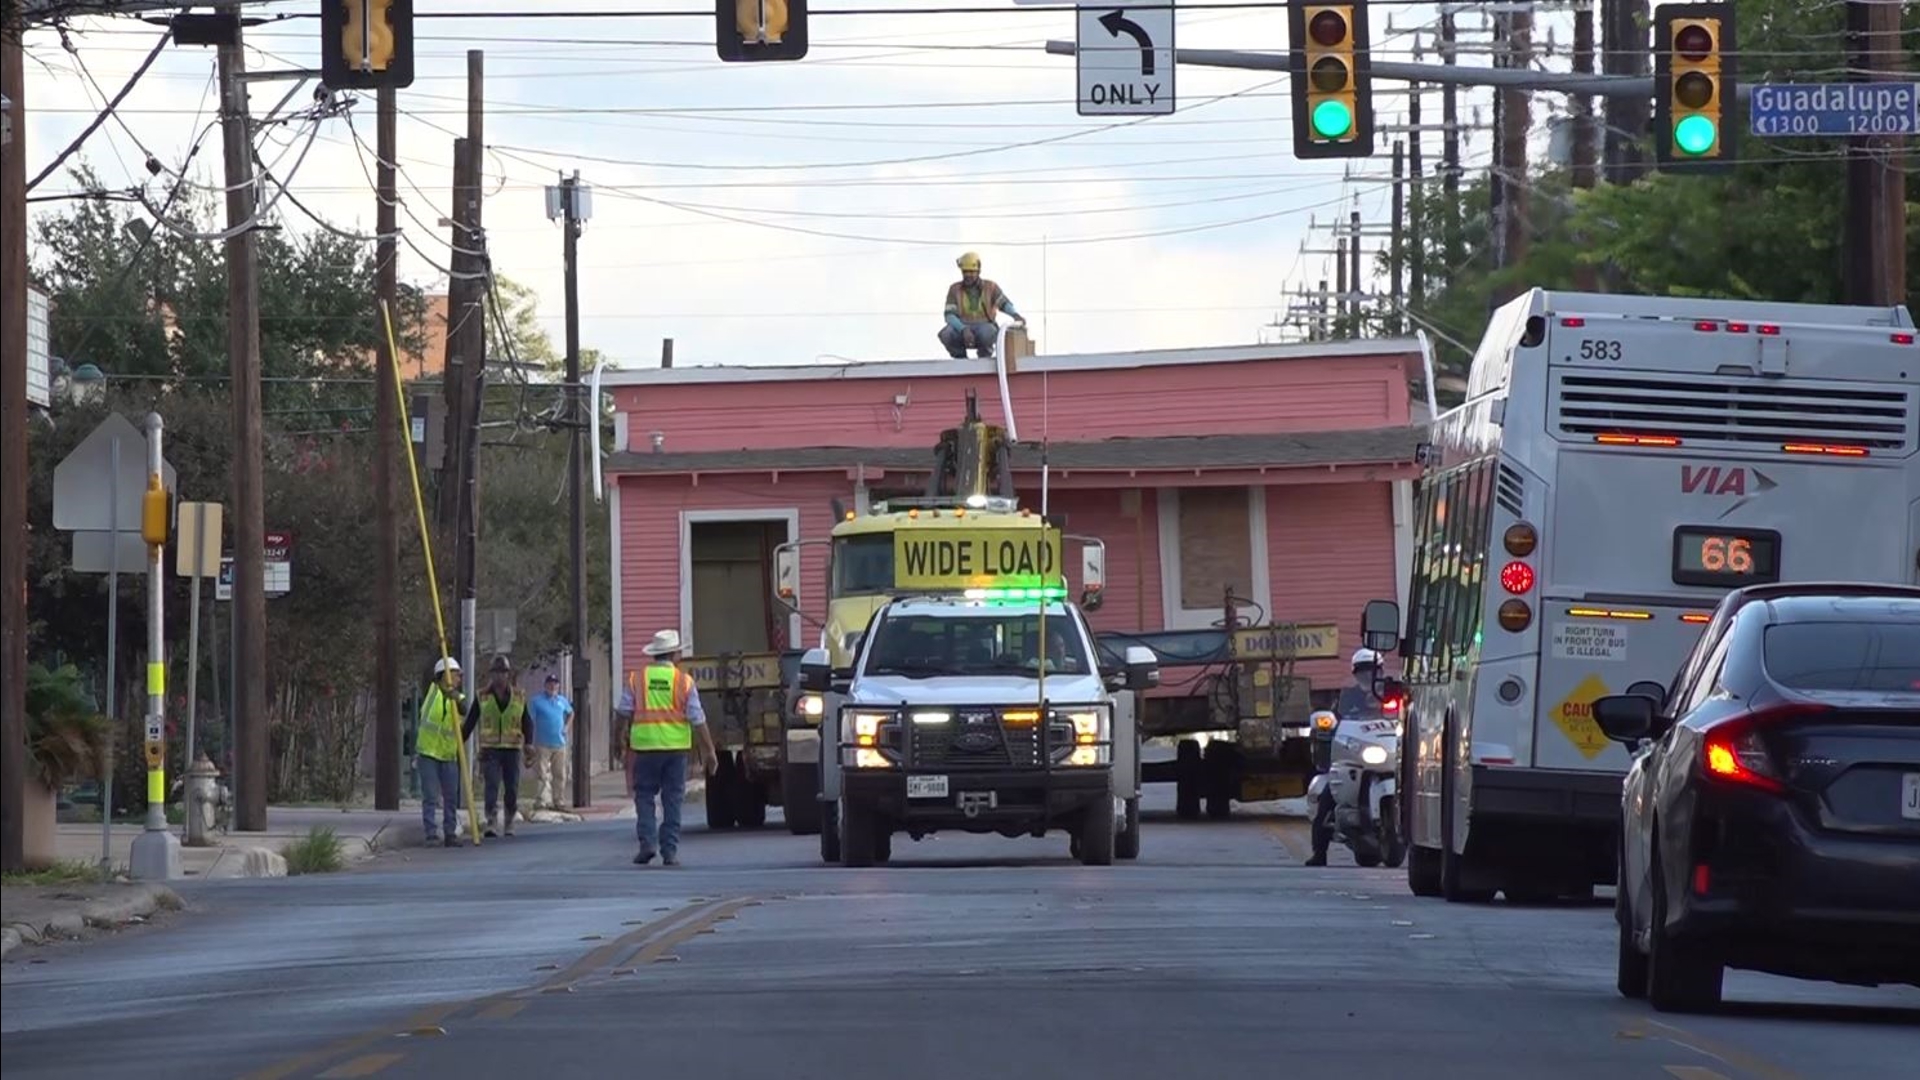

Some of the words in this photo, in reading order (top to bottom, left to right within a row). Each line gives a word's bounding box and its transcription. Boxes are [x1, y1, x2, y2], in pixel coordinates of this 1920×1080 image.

[1090, 83, 1161, 105] ONLY
[1756, 84, 1910, 118] Guadalupe
[1769, 115, 1819, 133] 1300
[1847, 114, 1898, 132] 1200
[1580, 339, 1622, 361] 583
[1681, 465, 1745, 496] VIA
[904, 540, 972, 576] WIDE
[983, 540, 1053, 576] LOAD
[1701, 536, 1752, 572] 66
[1553, 635, 1563, 645] IN
[1565, 636, 1592, 647] FRONT
[1594, 637, 1606, 647] OF
[1608, 638, 1626, 648] BUS
[1565, 626, 1591, 636] RIGHT
[1592, 627, 1616, 638] TURN
[1566, 646, 1575, 656] IS
[1576, 646, 1612, 657] ILLEGAL
[1562, 702, 1591, 717] CAU
